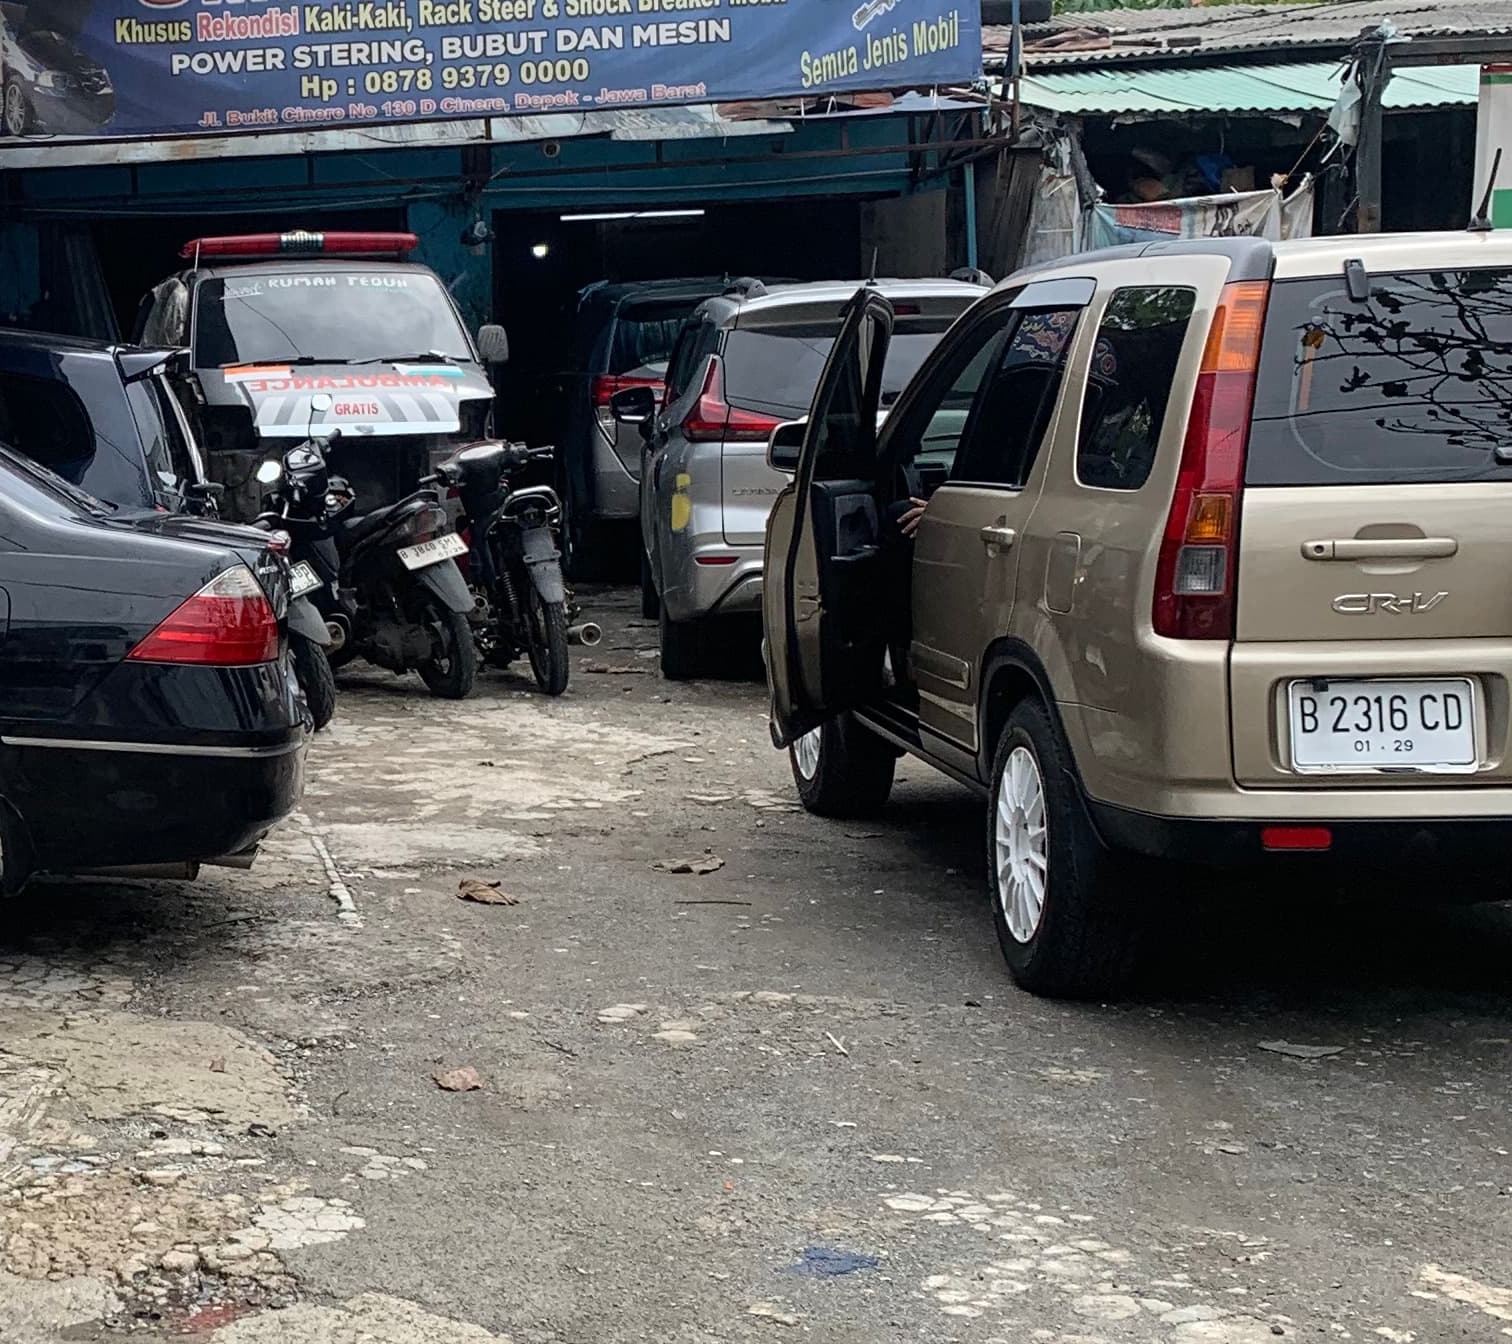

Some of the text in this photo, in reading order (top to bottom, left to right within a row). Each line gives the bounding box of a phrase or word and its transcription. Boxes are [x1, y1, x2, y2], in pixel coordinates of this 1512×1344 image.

[115, 17, 192, 44] Khusus
[197, 6, 299, 43] Rekondisi
[304, 0, 413, 33] Kaki-Kaki,
[171, 18, 731, 76] POWER STERING, BUBUT DAN MESIN
[800, 9, 959, 89] Semua Jenis Mobil
[301, 76, 338, 102] Hp
[364, 69, 433, 94] 0878
[441, 63, 511, 89] 9379
[519, 58, 590, 84] 0000
[198, 111, 222, 127] Jl.
[226, 109, 278, 126] Bukit
[349, 103, 377, 119] No
[381, 99, 417, 117] 130
[420, 98, 437, 114] D
[439, 96, 510, 113] Cinere,
[514, 90, 579, 110] Depok
[595, 87, 648, 104] Jawa
[651, 82, 706, 100] Barat
[268, 275, 336, 289] RUMAH
[334, 401, 379, 416] GRATIS
[1331, 591, 1449, 615] CR-V
[1299, 693, 1463, 734] B 2316 CD
